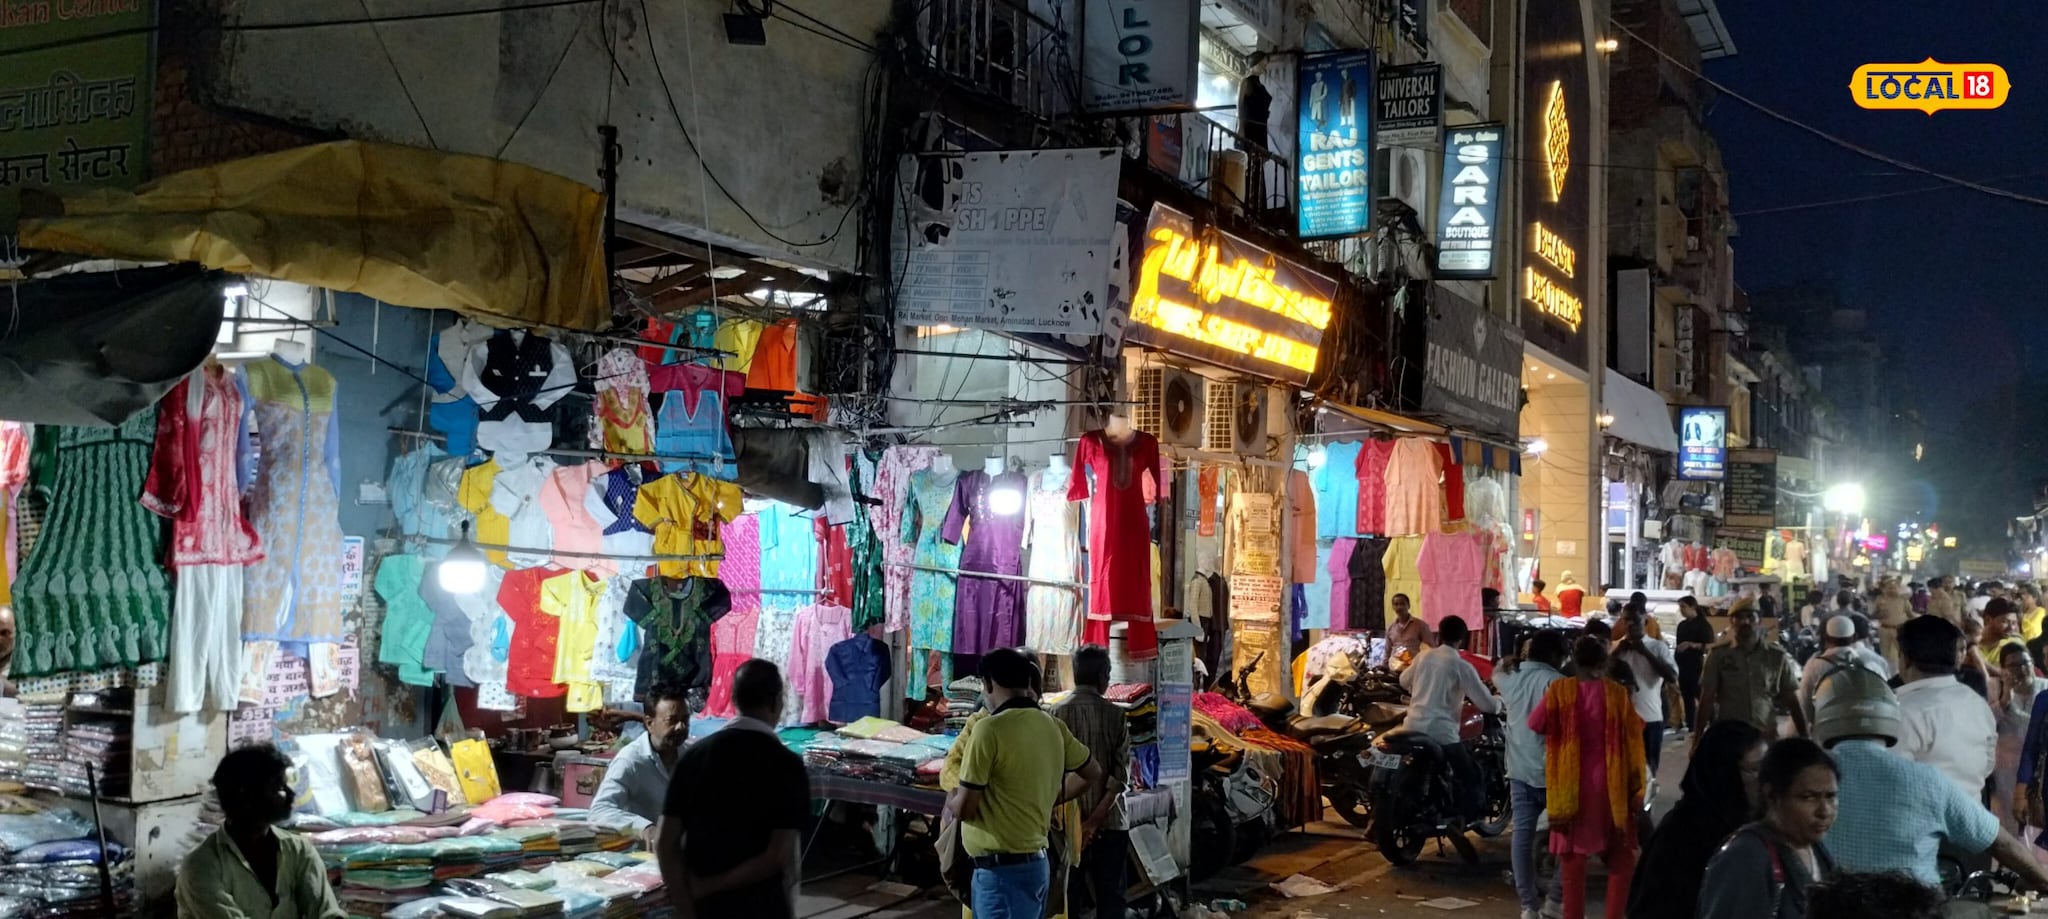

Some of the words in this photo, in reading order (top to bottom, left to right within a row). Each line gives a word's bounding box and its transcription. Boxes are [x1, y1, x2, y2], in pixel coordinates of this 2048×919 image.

[1117, 7, 1153, 85] LOR
[1379, 76, 1436, 101] UNIVERSAL
[1384, 97, 1431, 119] TAILORS
[1310, 128, 1359, 152] RAJ
[58, 137, 130, 182] सेन्टर
[1303, 149, 1365, 172] GENTS
[1299, 170, 1367, 192] TAILOR
[1447, 145, 1490, 226] SARA
[1445, 226, 1490, 239] BOUTIQUE
[1038, 317, 1071, 328] Lucknow
[1426, 342, 1477, 399] FASHION
[1477, 363, 1520, 412] GALLERY
